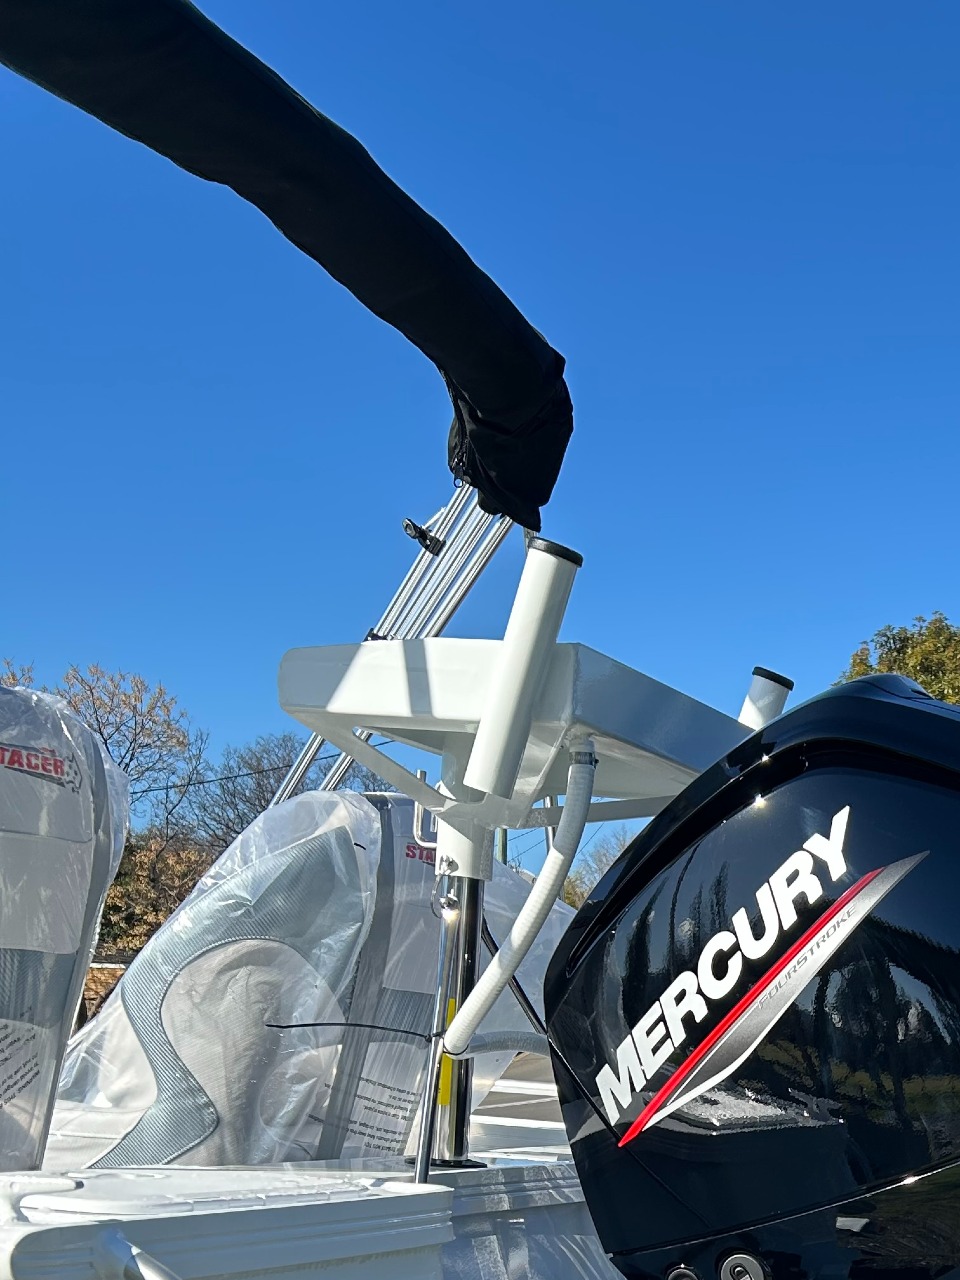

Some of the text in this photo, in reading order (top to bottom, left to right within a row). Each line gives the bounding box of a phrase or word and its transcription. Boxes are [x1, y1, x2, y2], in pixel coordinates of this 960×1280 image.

[0, 746, 65, 777] TACER
[405, 844, 437, 864] STA
[595, 805, 850, 1127] MERCURY
[758, 904, 858, 1010] FOURSTROKE
